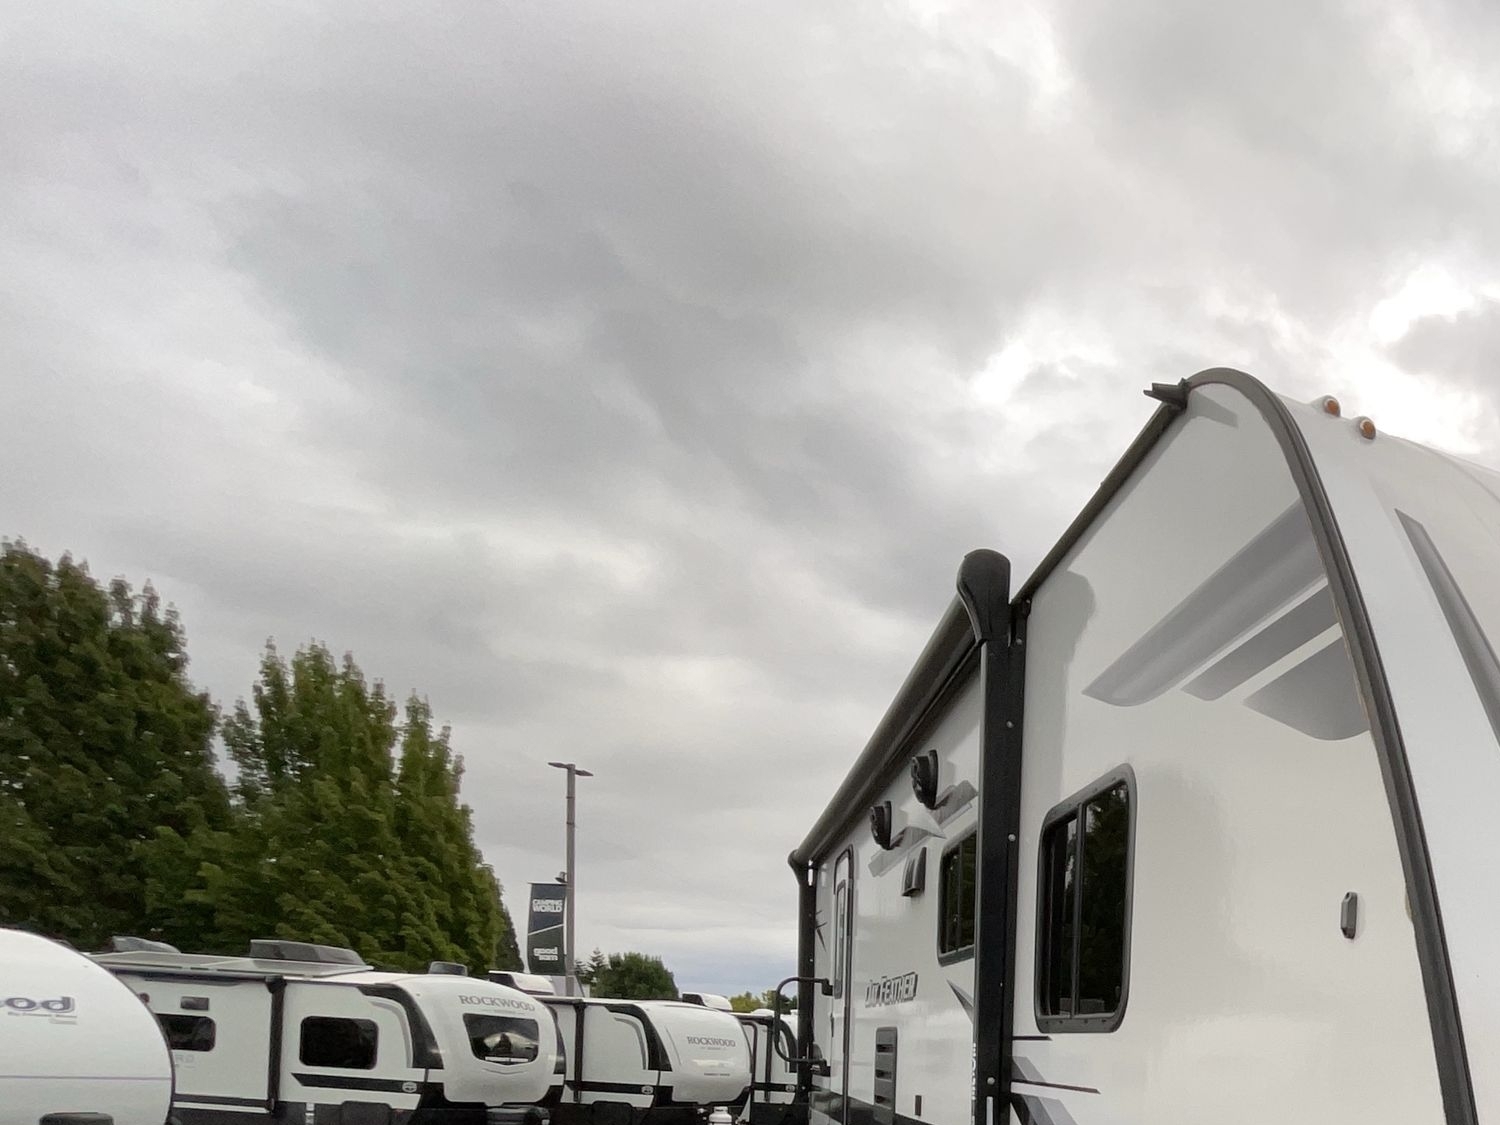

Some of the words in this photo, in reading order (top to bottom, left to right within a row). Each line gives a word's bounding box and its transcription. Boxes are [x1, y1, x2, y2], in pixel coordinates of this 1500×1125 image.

[532, 904, 563, 913] WORLD
[533, 947, 558, 956] good
[458, 995, 536, 1011] ROCKWOOD
[686, 1036, 736, 1048] ROCKWOOD
